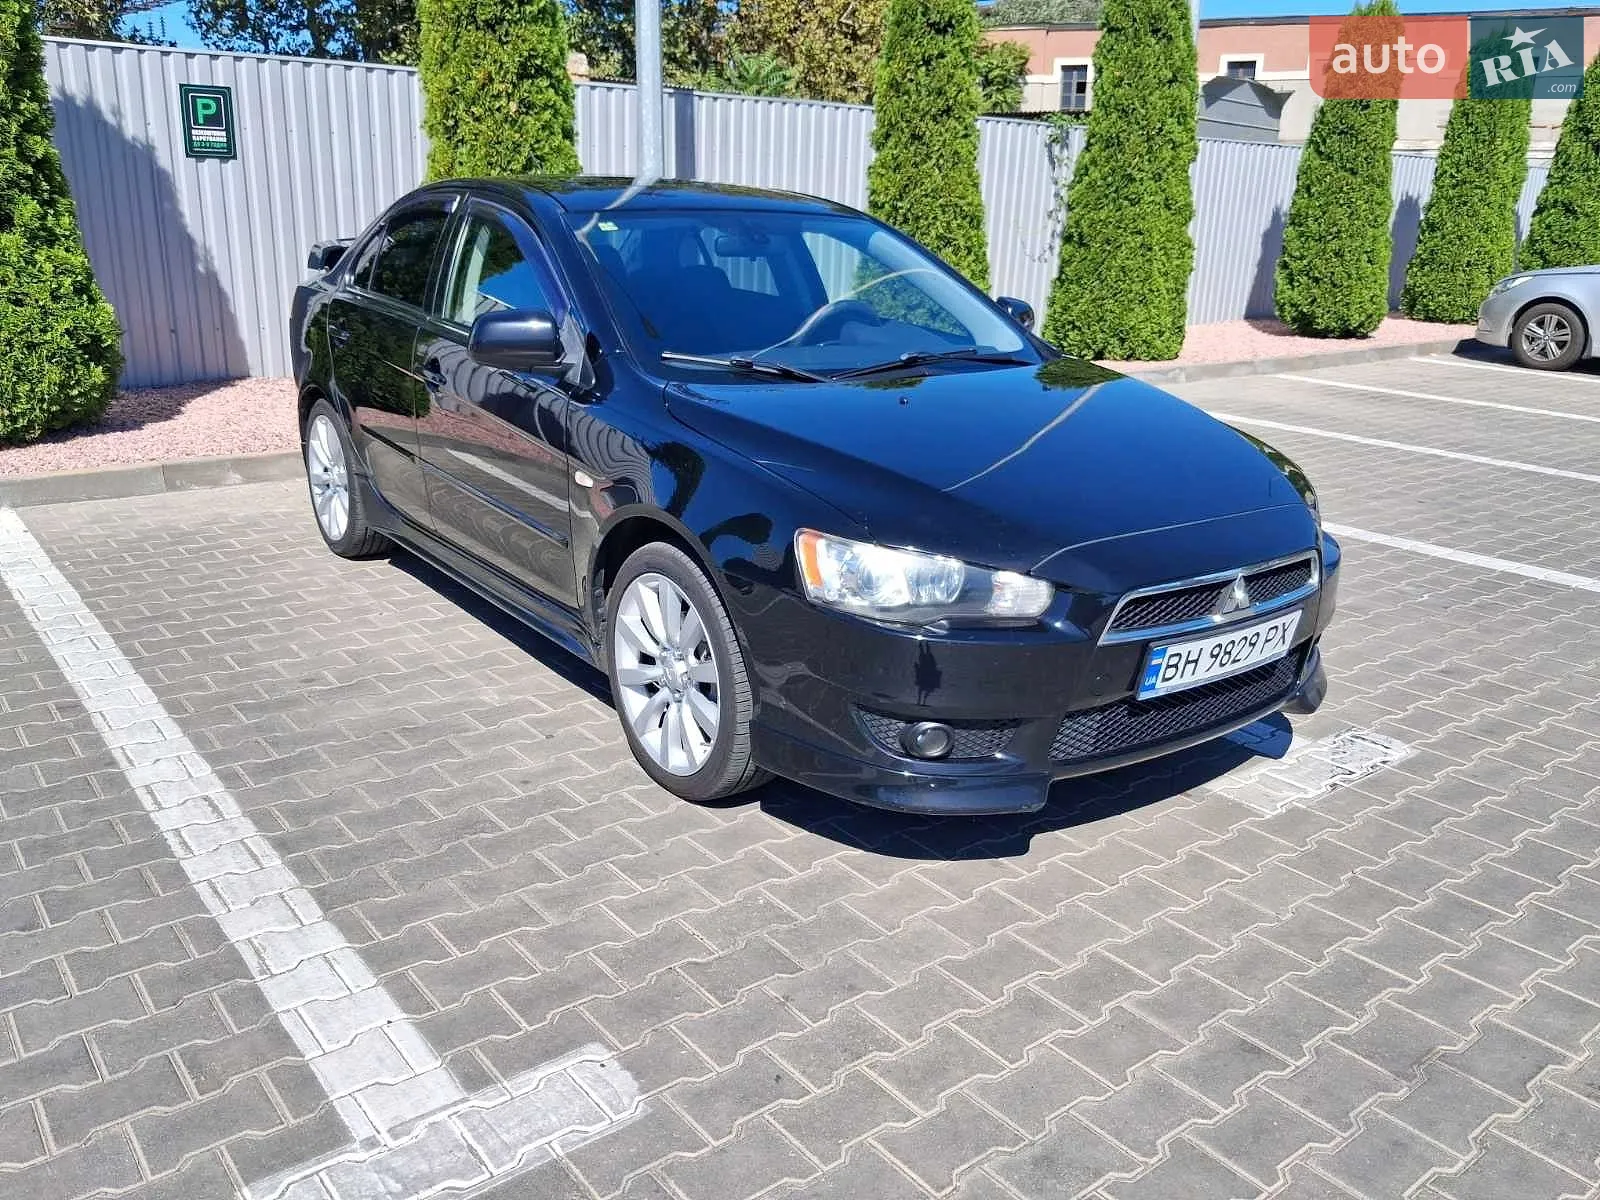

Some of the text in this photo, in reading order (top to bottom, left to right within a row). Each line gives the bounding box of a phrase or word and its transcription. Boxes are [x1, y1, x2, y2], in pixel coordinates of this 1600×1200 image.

[196, 98, 217, 125] P
[1160, 616, 1296, 683] BH 9829 PX
[1144, 676, 1157, 687] UA
